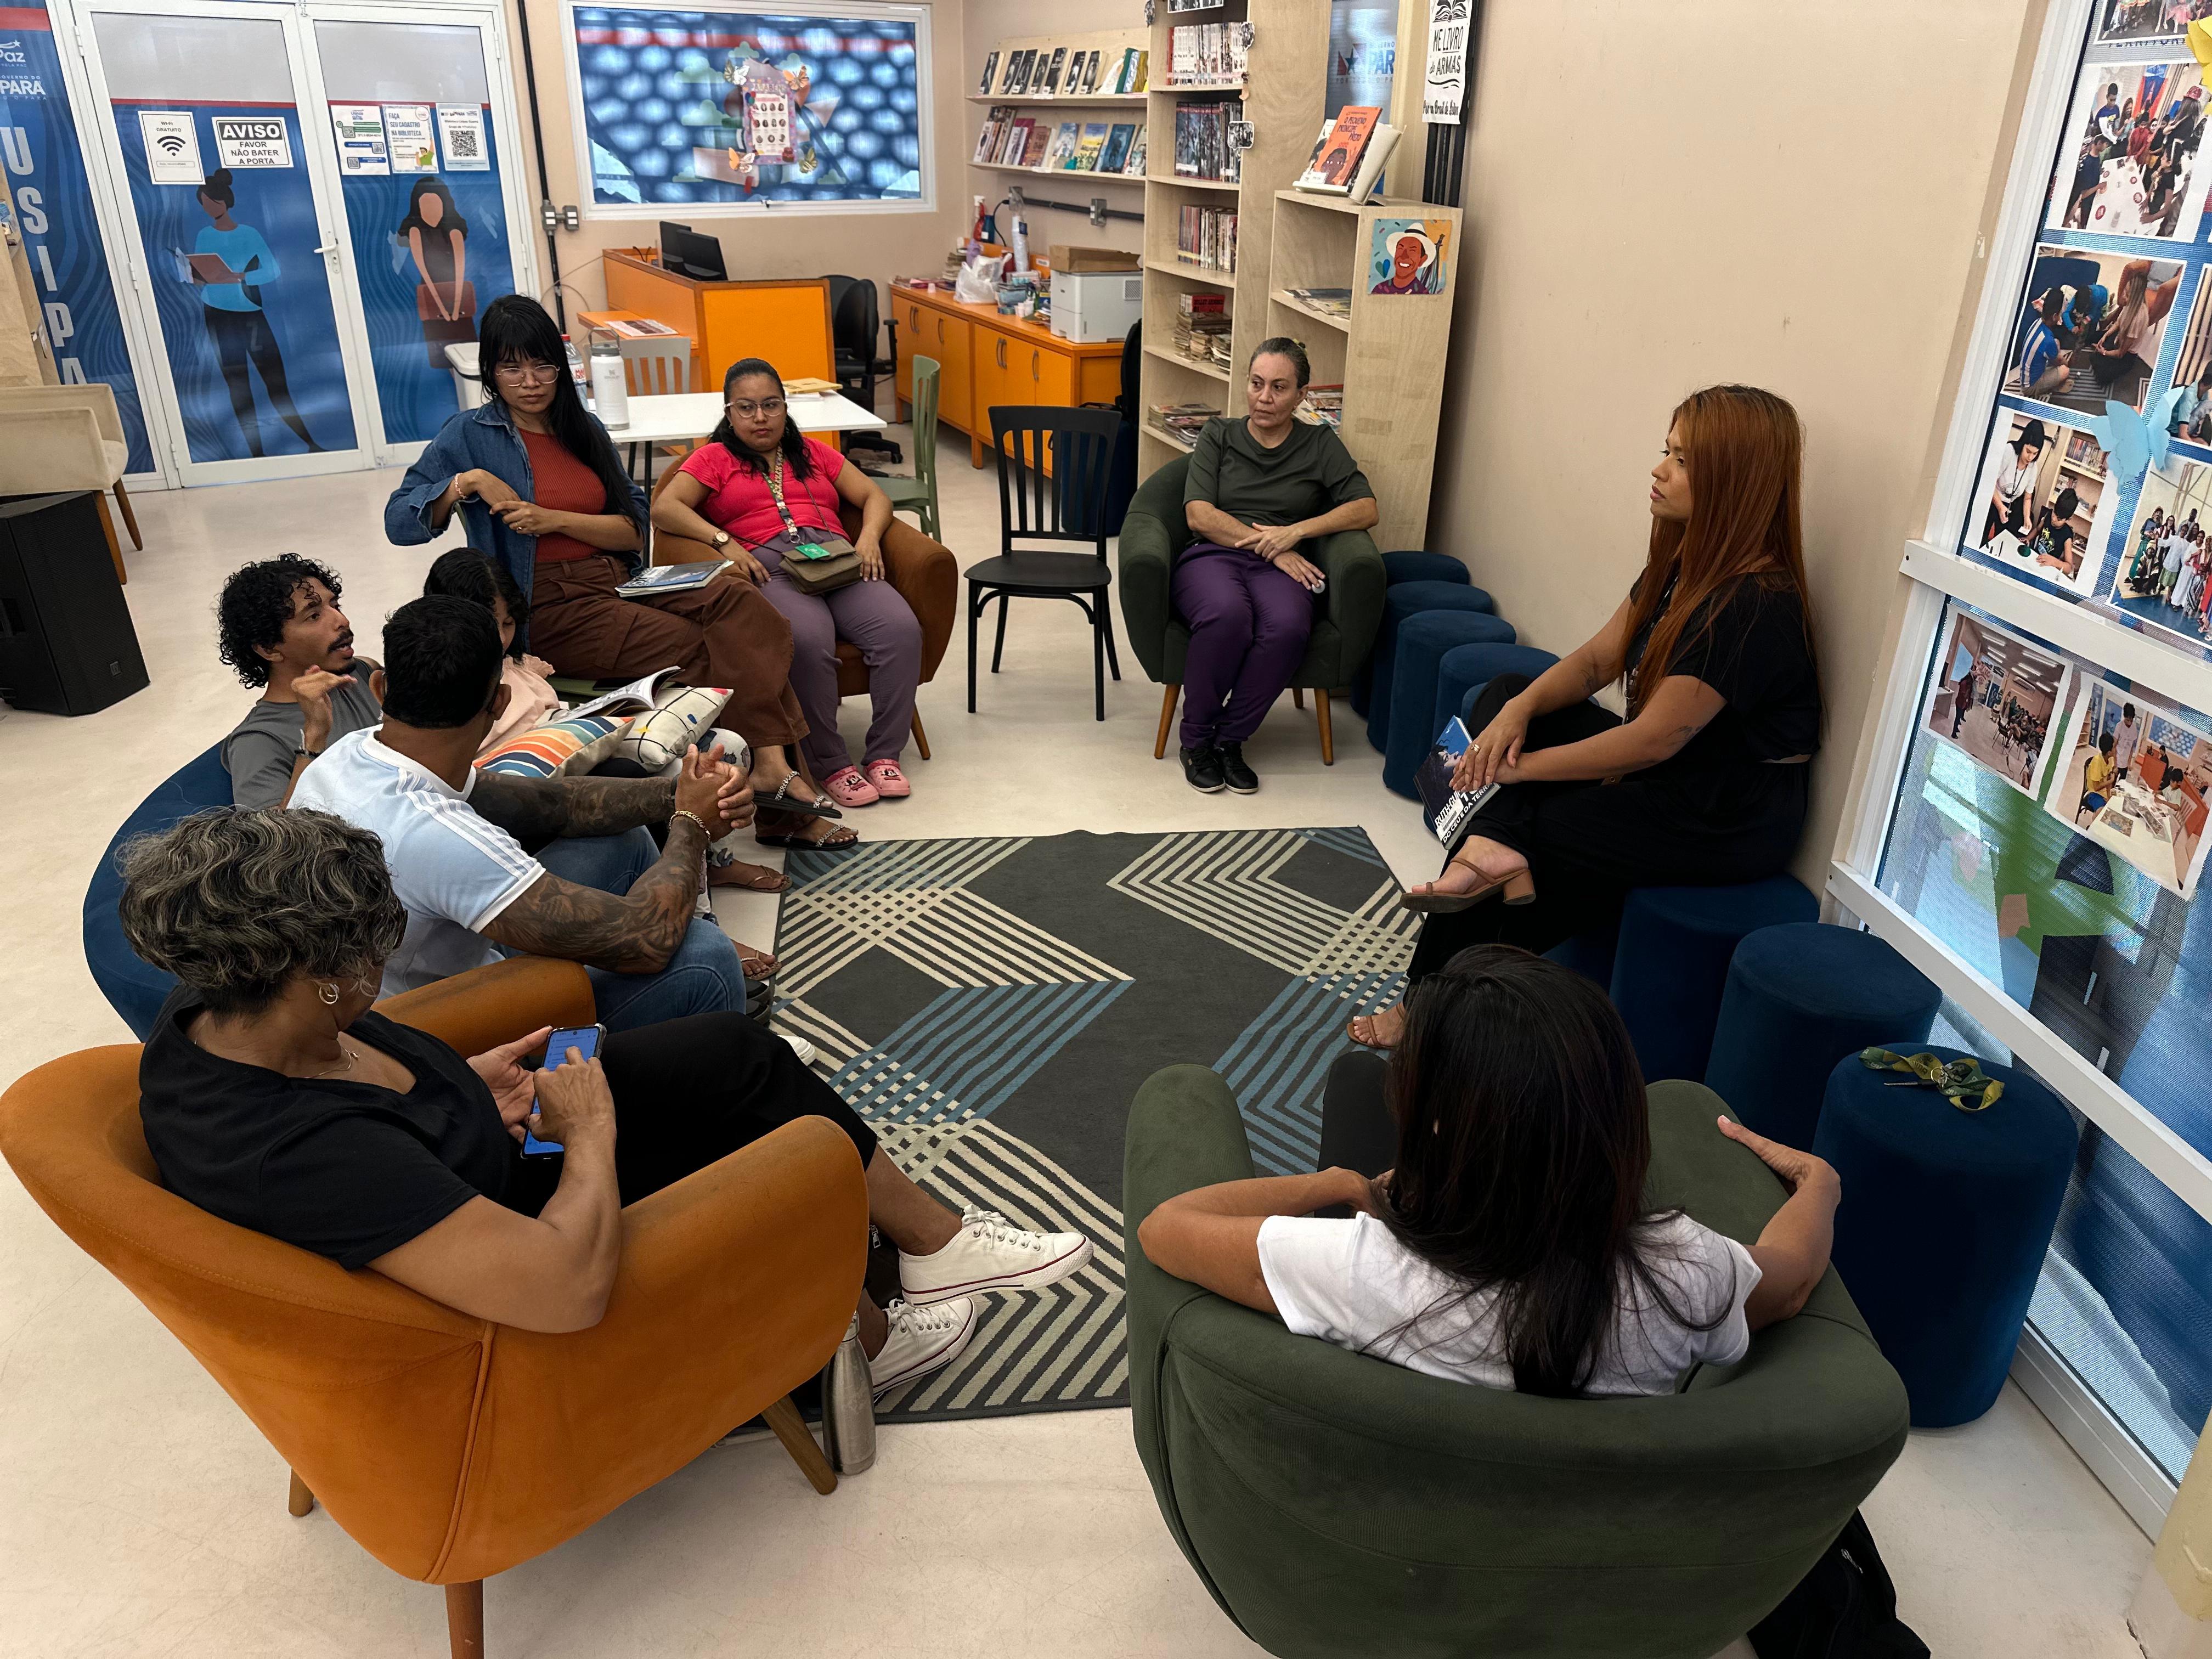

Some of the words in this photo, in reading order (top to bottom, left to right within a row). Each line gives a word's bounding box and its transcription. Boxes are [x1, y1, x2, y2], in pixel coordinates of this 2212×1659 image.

[1443, 26, 1464, 51] LIVRO
[1436, 55, 1461, 76] ARMAS
[223, 125, 280, 138] AVISO
[1435, 803, 1450, 826] RUTH
[1443, 831, 1452, 843] DO
[1463, 802, 1474, 814] DA
